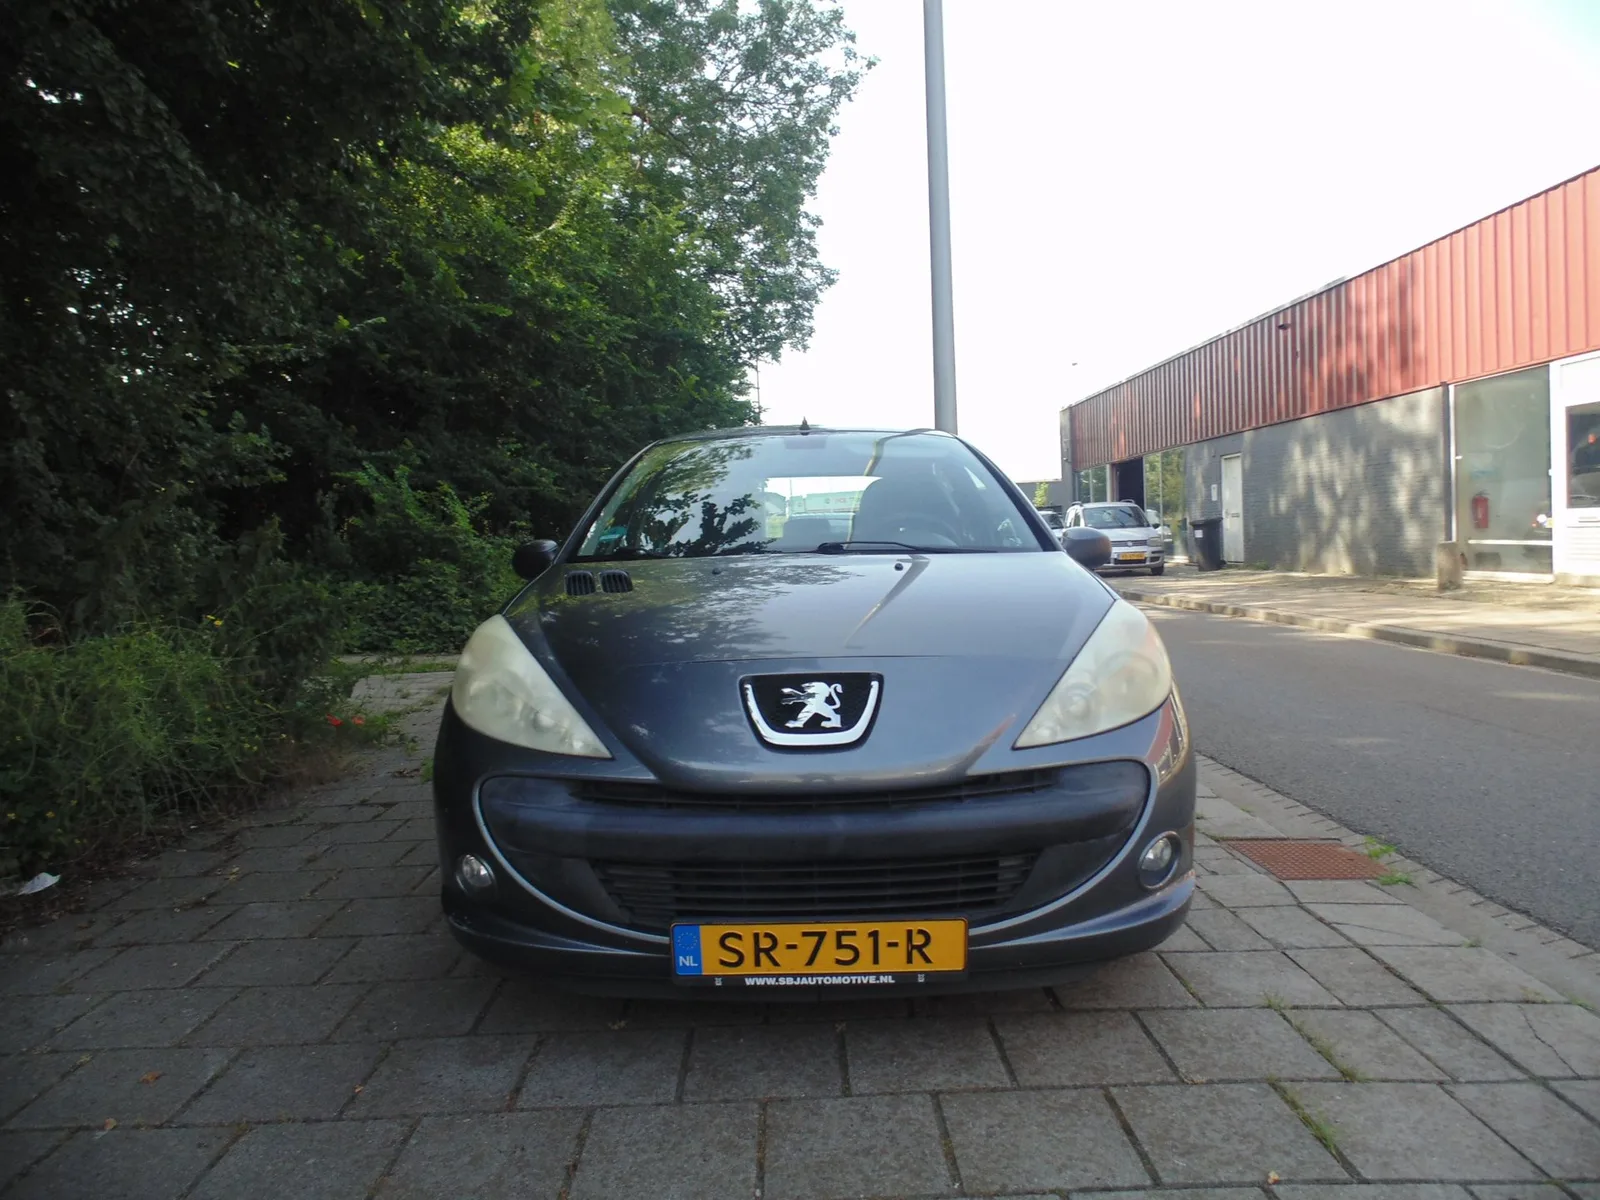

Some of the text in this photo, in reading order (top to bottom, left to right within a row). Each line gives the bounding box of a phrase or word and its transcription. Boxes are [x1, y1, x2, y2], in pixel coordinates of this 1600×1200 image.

[718, 928, 933, 968] SR-751-R
[679, 955, 698, 967] NL
[744, 975, 895, 986] WWW.SBJAUTOMOTIVE.NL
